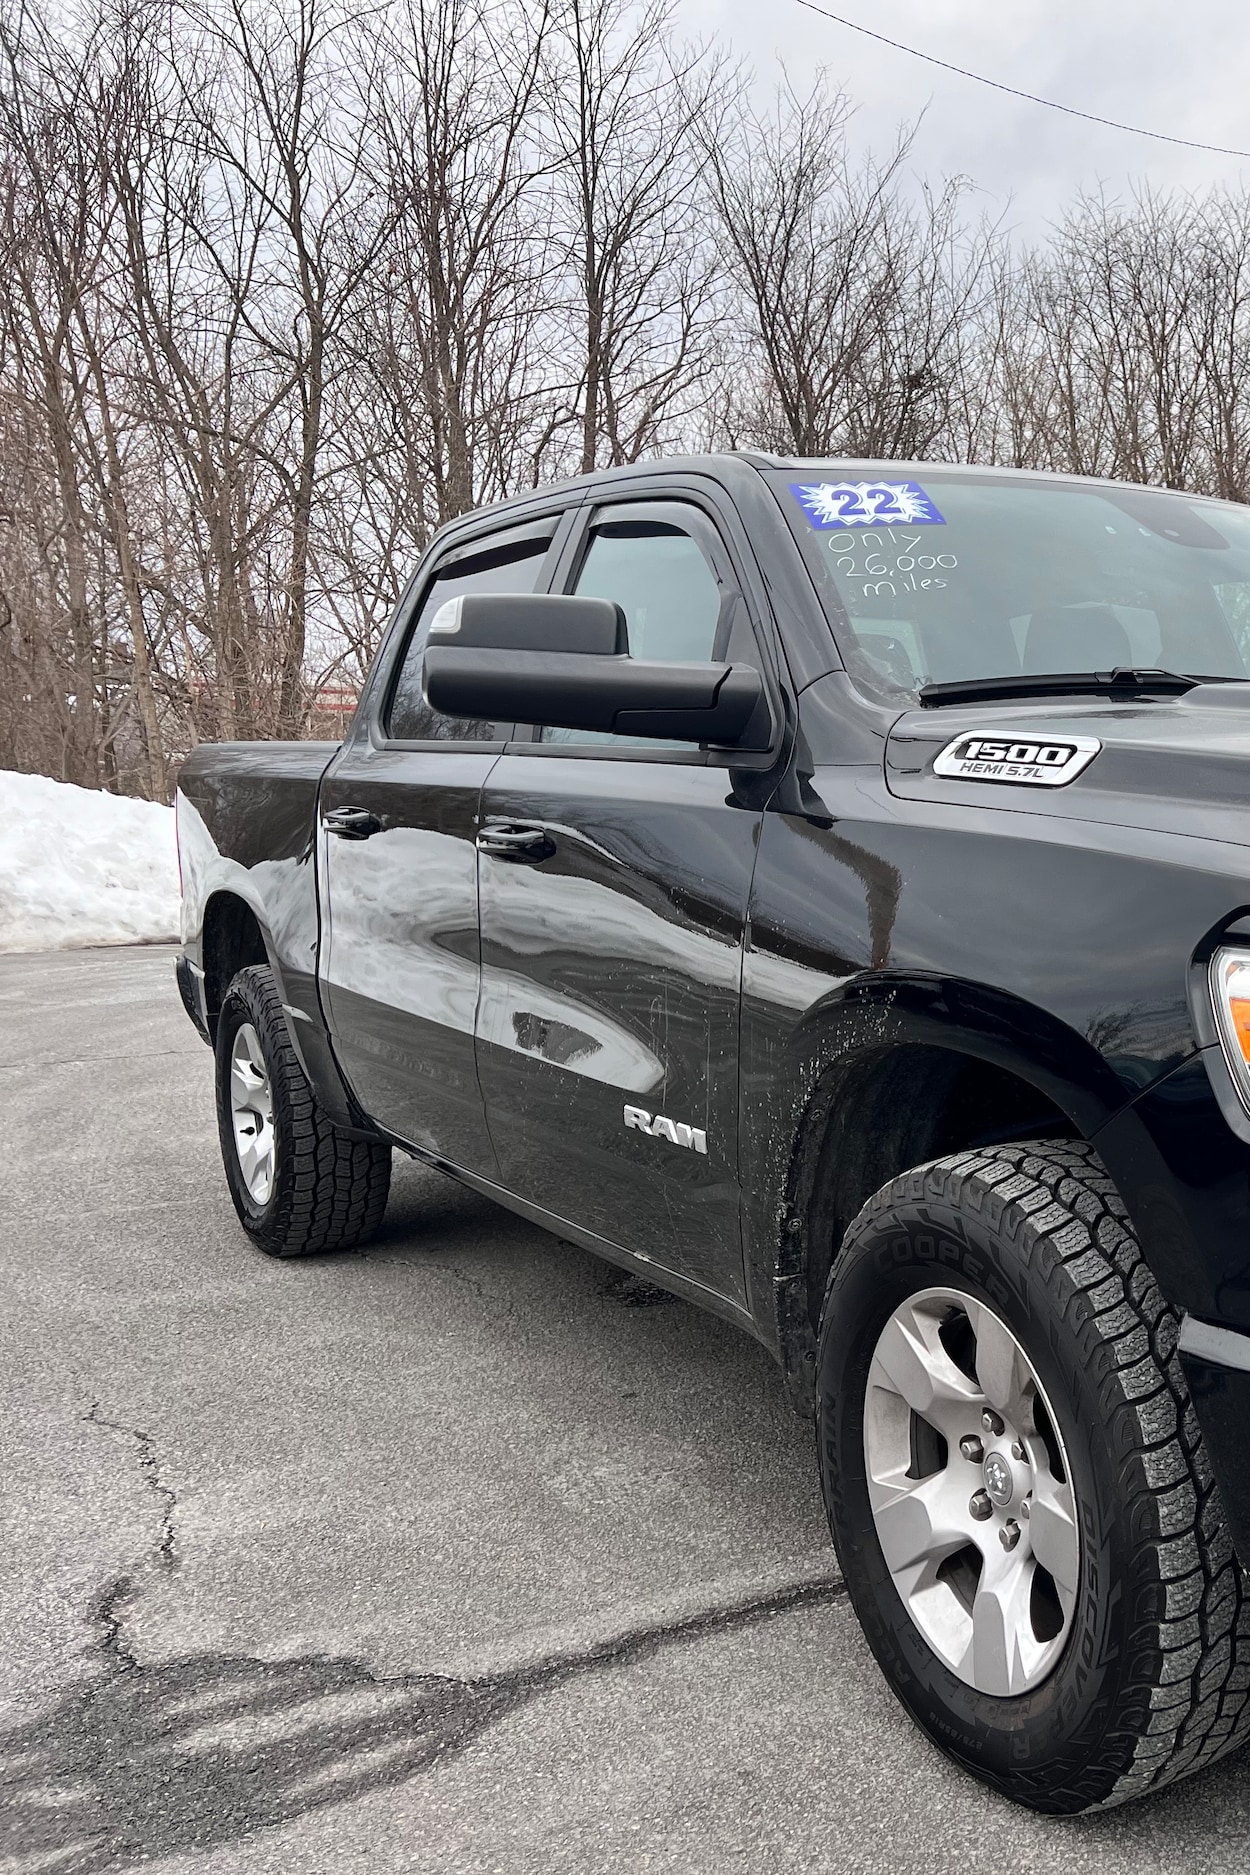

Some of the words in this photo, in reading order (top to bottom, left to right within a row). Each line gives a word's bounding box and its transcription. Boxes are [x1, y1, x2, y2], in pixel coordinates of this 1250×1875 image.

[831, 488, 906, 517] 22
[836, 553, 958, 577] 26,000
[862, 573, 949, 598] miles
[964, 741, 1073, 766] 1500
[959, 762, 1004, 775] HEMI
[1005, 766, 1044, 778] 5.7L
[623, 1104, 708, 1155] RAM
[873, 1235, 1009, 1308] COOPER
